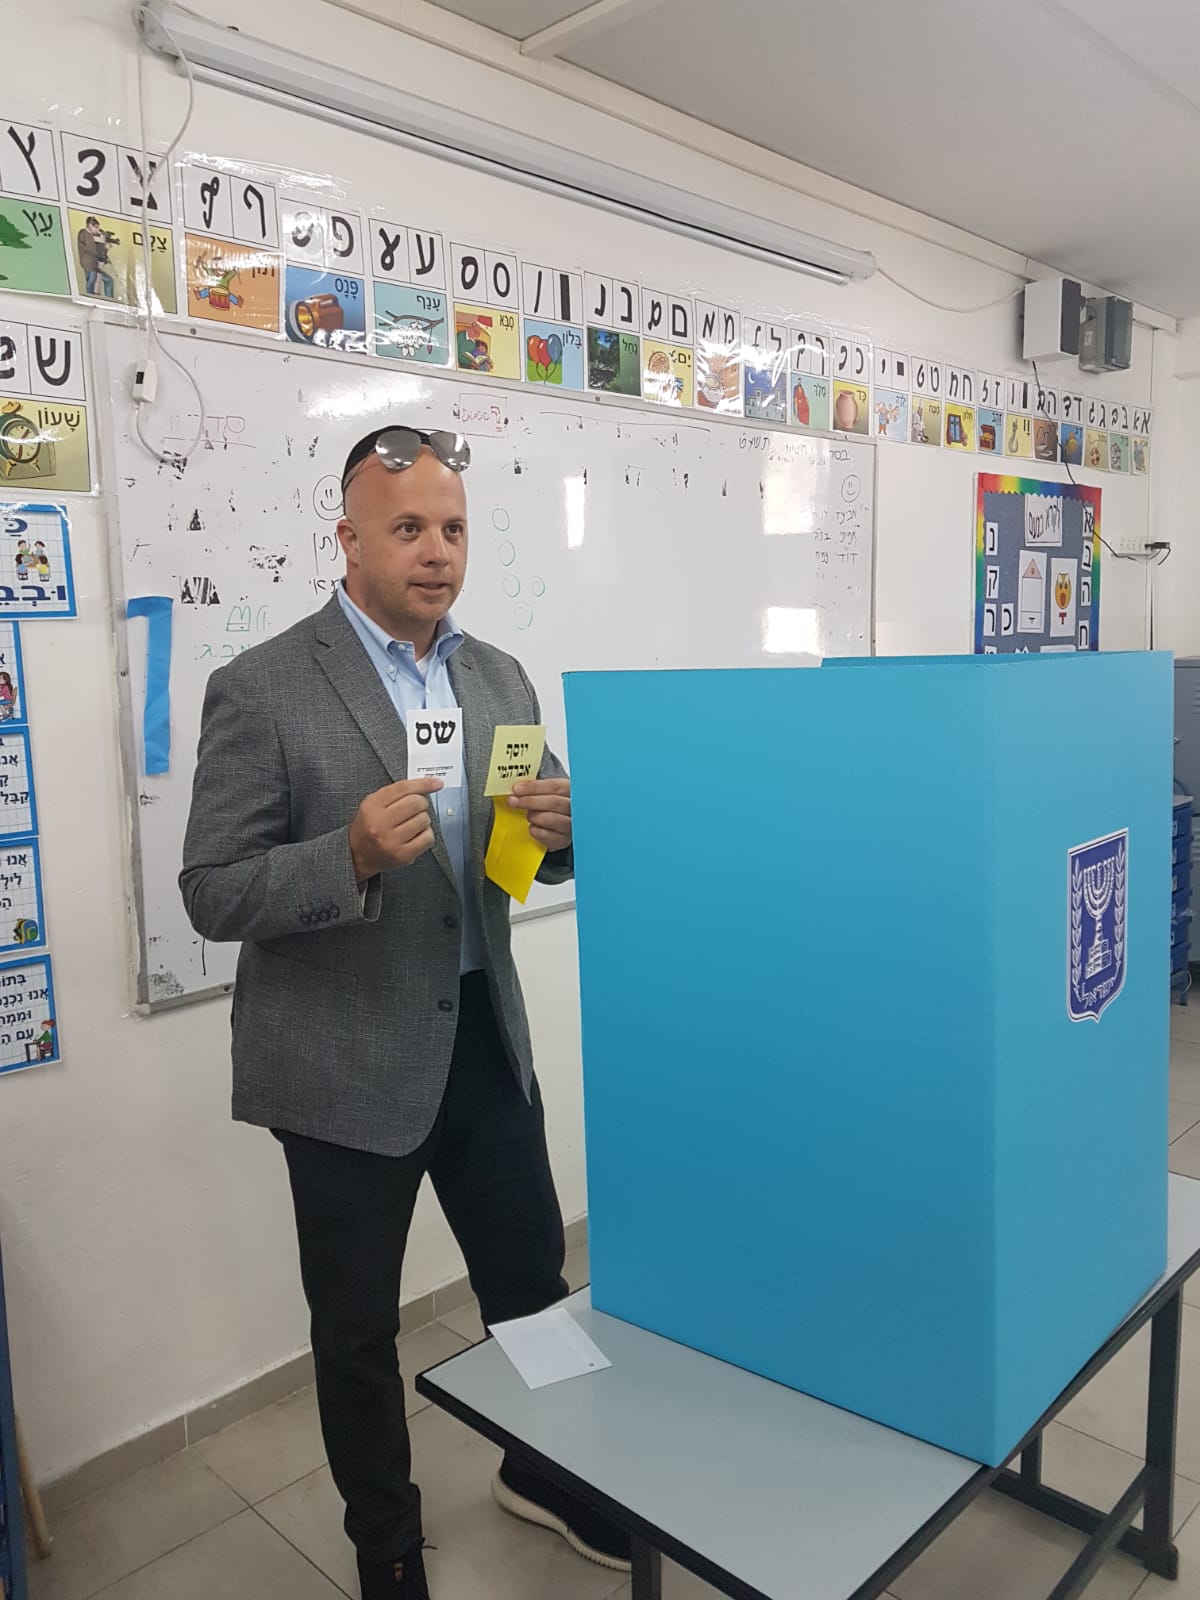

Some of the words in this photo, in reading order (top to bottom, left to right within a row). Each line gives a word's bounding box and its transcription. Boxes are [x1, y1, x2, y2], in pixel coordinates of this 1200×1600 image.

[415, 233, 435, 275] ע
[493, 261, 511, 298] ס
[671, 304, 688, 338] ם
[34, 335, 71, 386] ש
[1141, 411, 1151, 434] א
[415, 720, 456, 745] שס
[506, 743, 529, 761] יוסף
[1082, 978, 1114, 1010] ישראל
